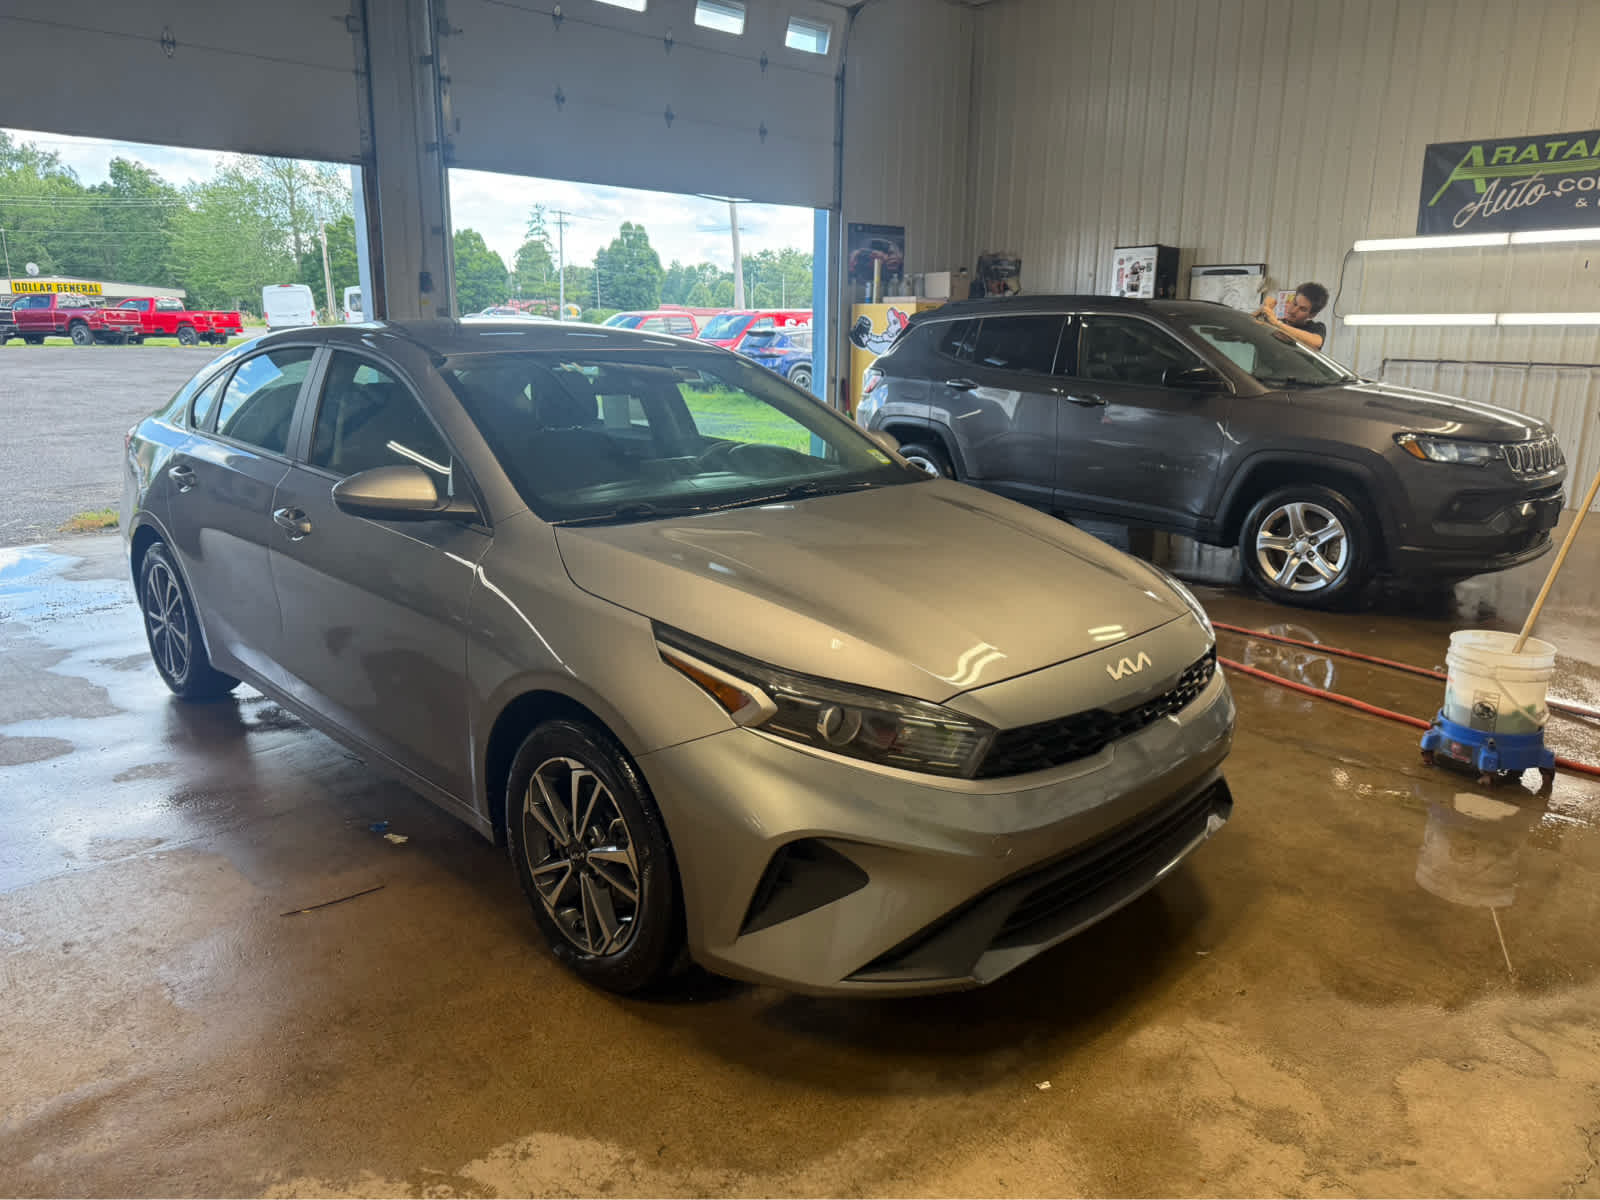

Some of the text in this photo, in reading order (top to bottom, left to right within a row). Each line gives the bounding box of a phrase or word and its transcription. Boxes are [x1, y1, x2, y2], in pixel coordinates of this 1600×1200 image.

[1558, 176, 1600, 192] CO
[14, 282, 99, 293] DOLLAR GENERAL
[1106, 651, 1152, 680] KIA
